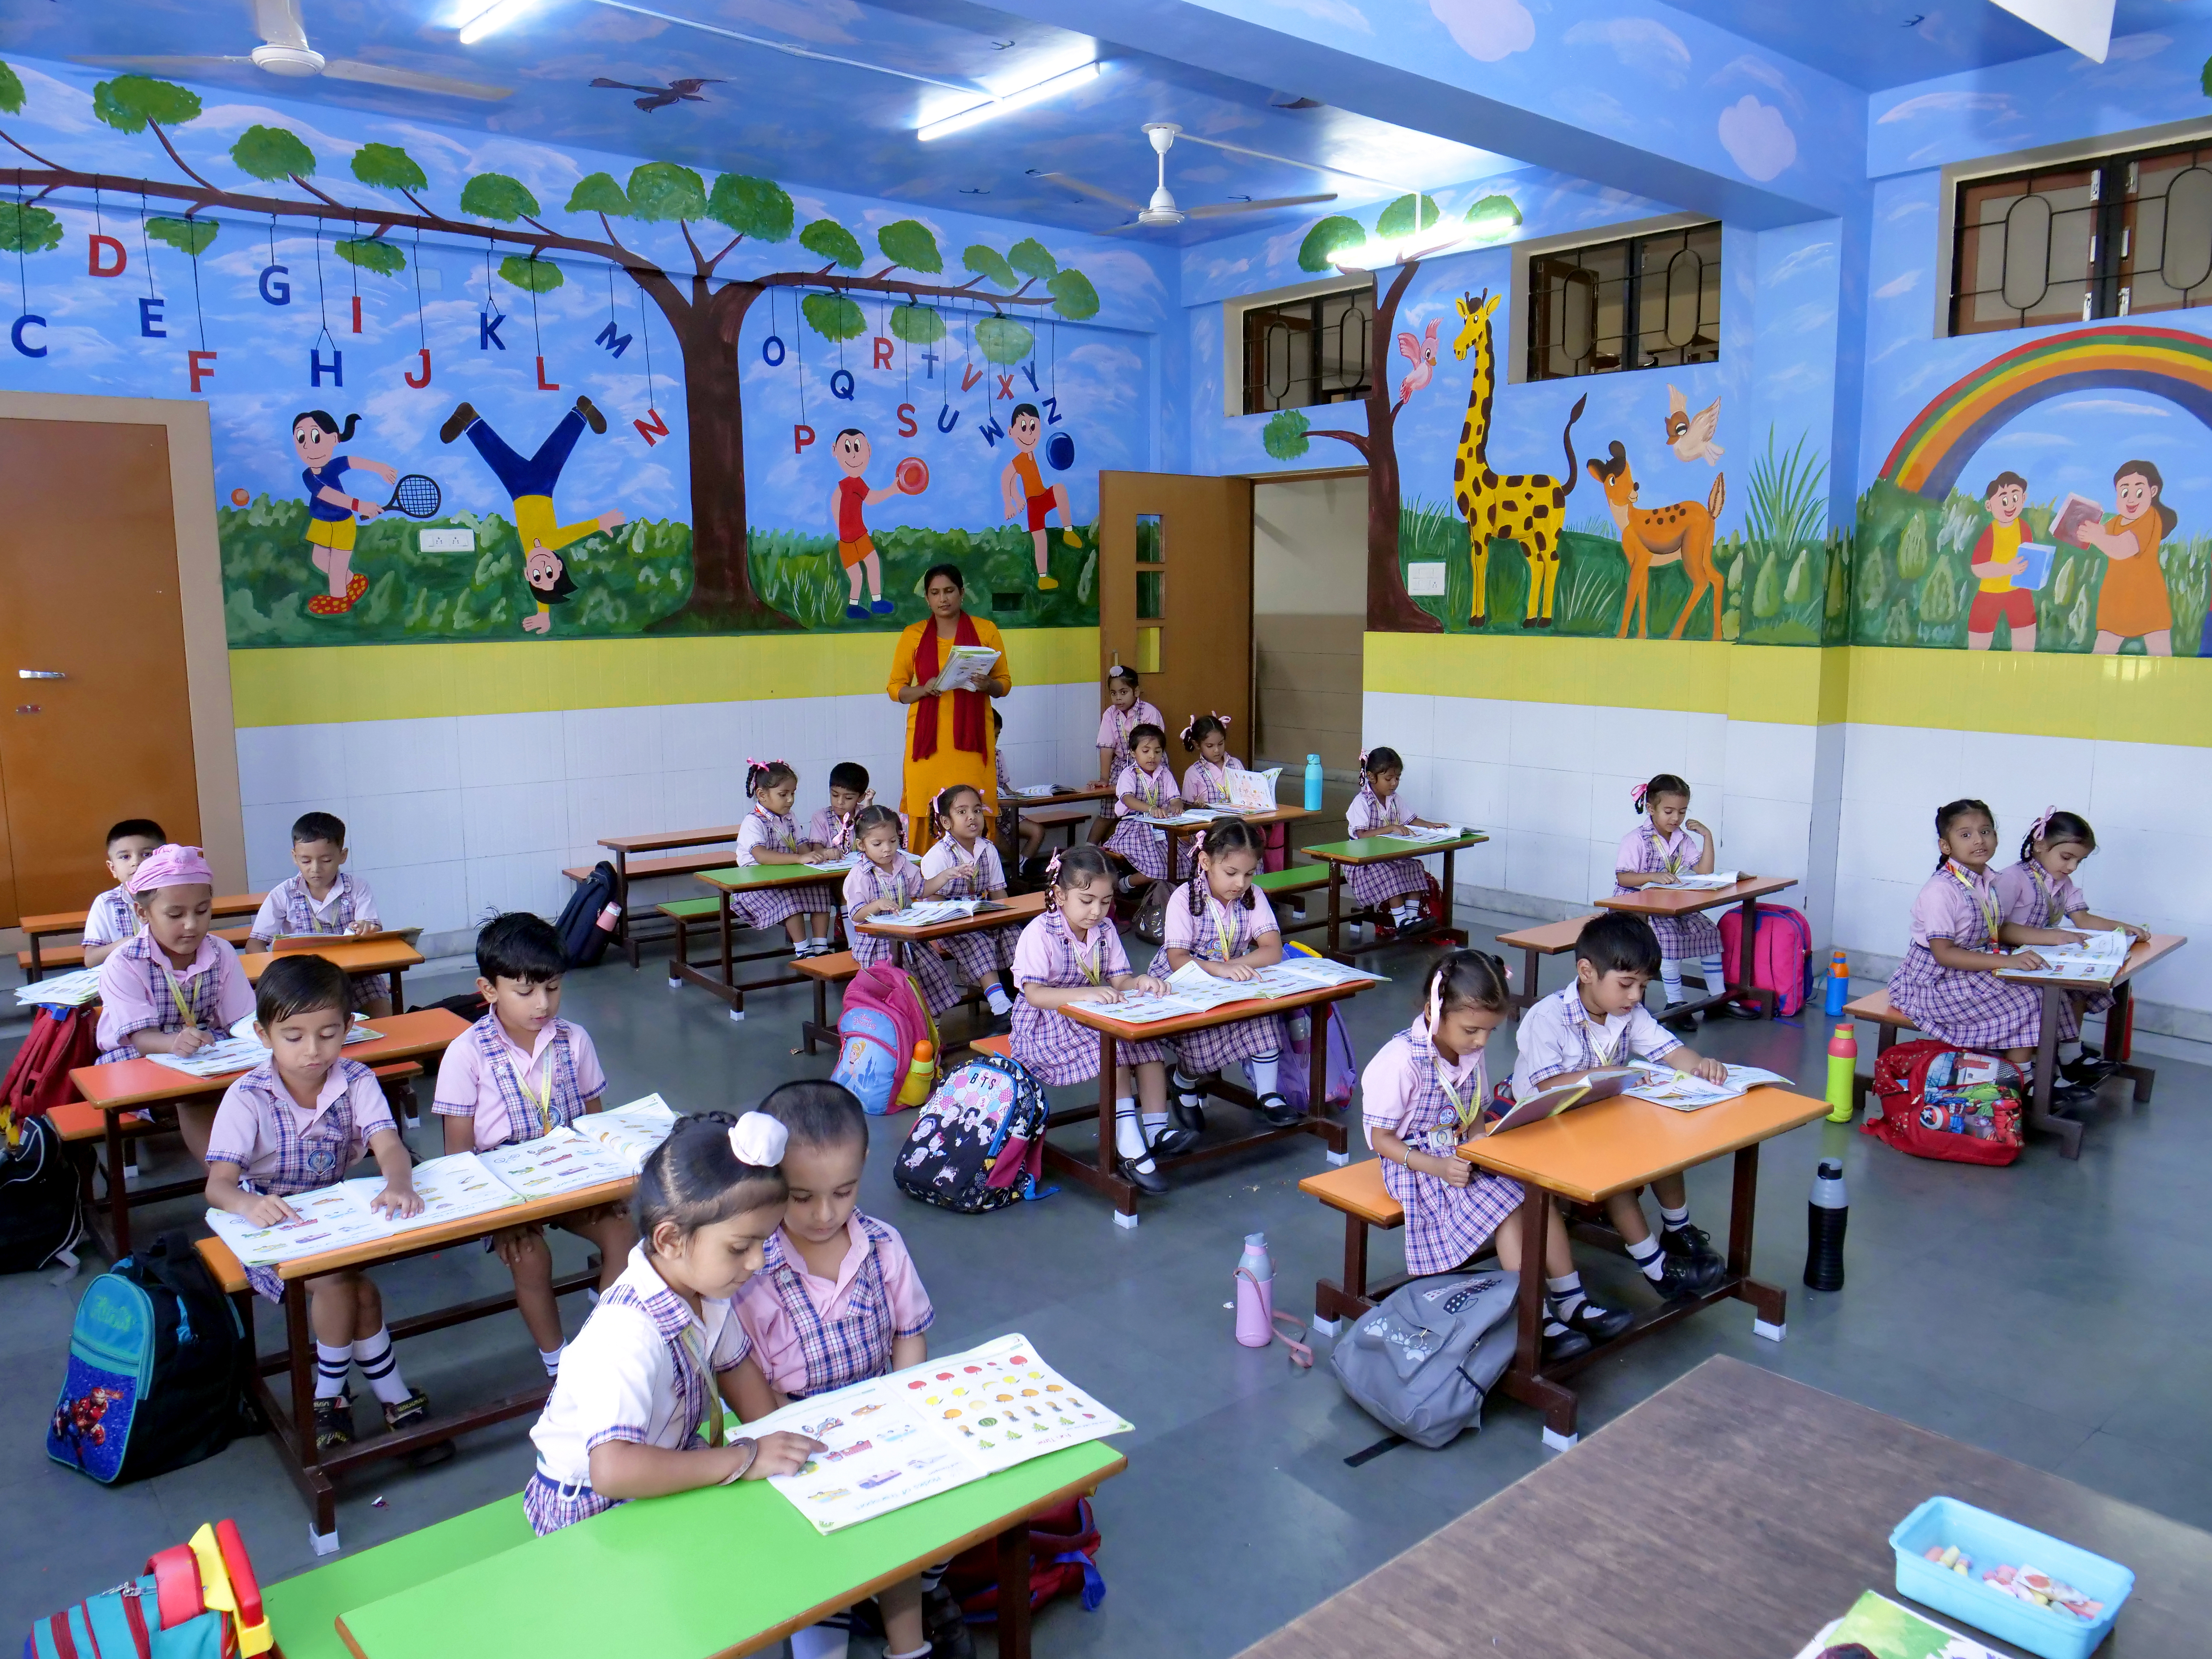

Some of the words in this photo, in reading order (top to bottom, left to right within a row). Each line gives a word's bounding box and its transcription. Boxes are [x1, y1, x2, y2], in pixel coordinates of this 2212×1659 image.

[11, 314, 47, 358] C
[89, 234, 127, 277] D
[139, 297, 167, 338] E
[188, 350, 217, 392] F
[259, 265, 290, 306] G
[311, 349, 343, 387] H
[352, 296, 362, 333] I
[405, 349, 431, 389] J
[480, 312, 506, 350] K
[536, 356, 560, 390] L
[595, 321, 632, 359] M
[633, 408, 670, 447] N
[762, 335, 785, 367] O
[794, 424, 816, 454] P
[830, 369, 855, 401] Q
[873, 337, 894, 370] R
[897, 403, 918, 437] S
[921, 354, 939, 379] T
[938, 404, 960, 433] U
[961, 363, 983, 392] V
[979, 416, 1005, 447] W
[997, 374, 1015, 400] X
[1021, 360, 1040, 392] Y
[1042, 397, 1063, 426] Z
[970, 1072, 997, 1090] BTS
